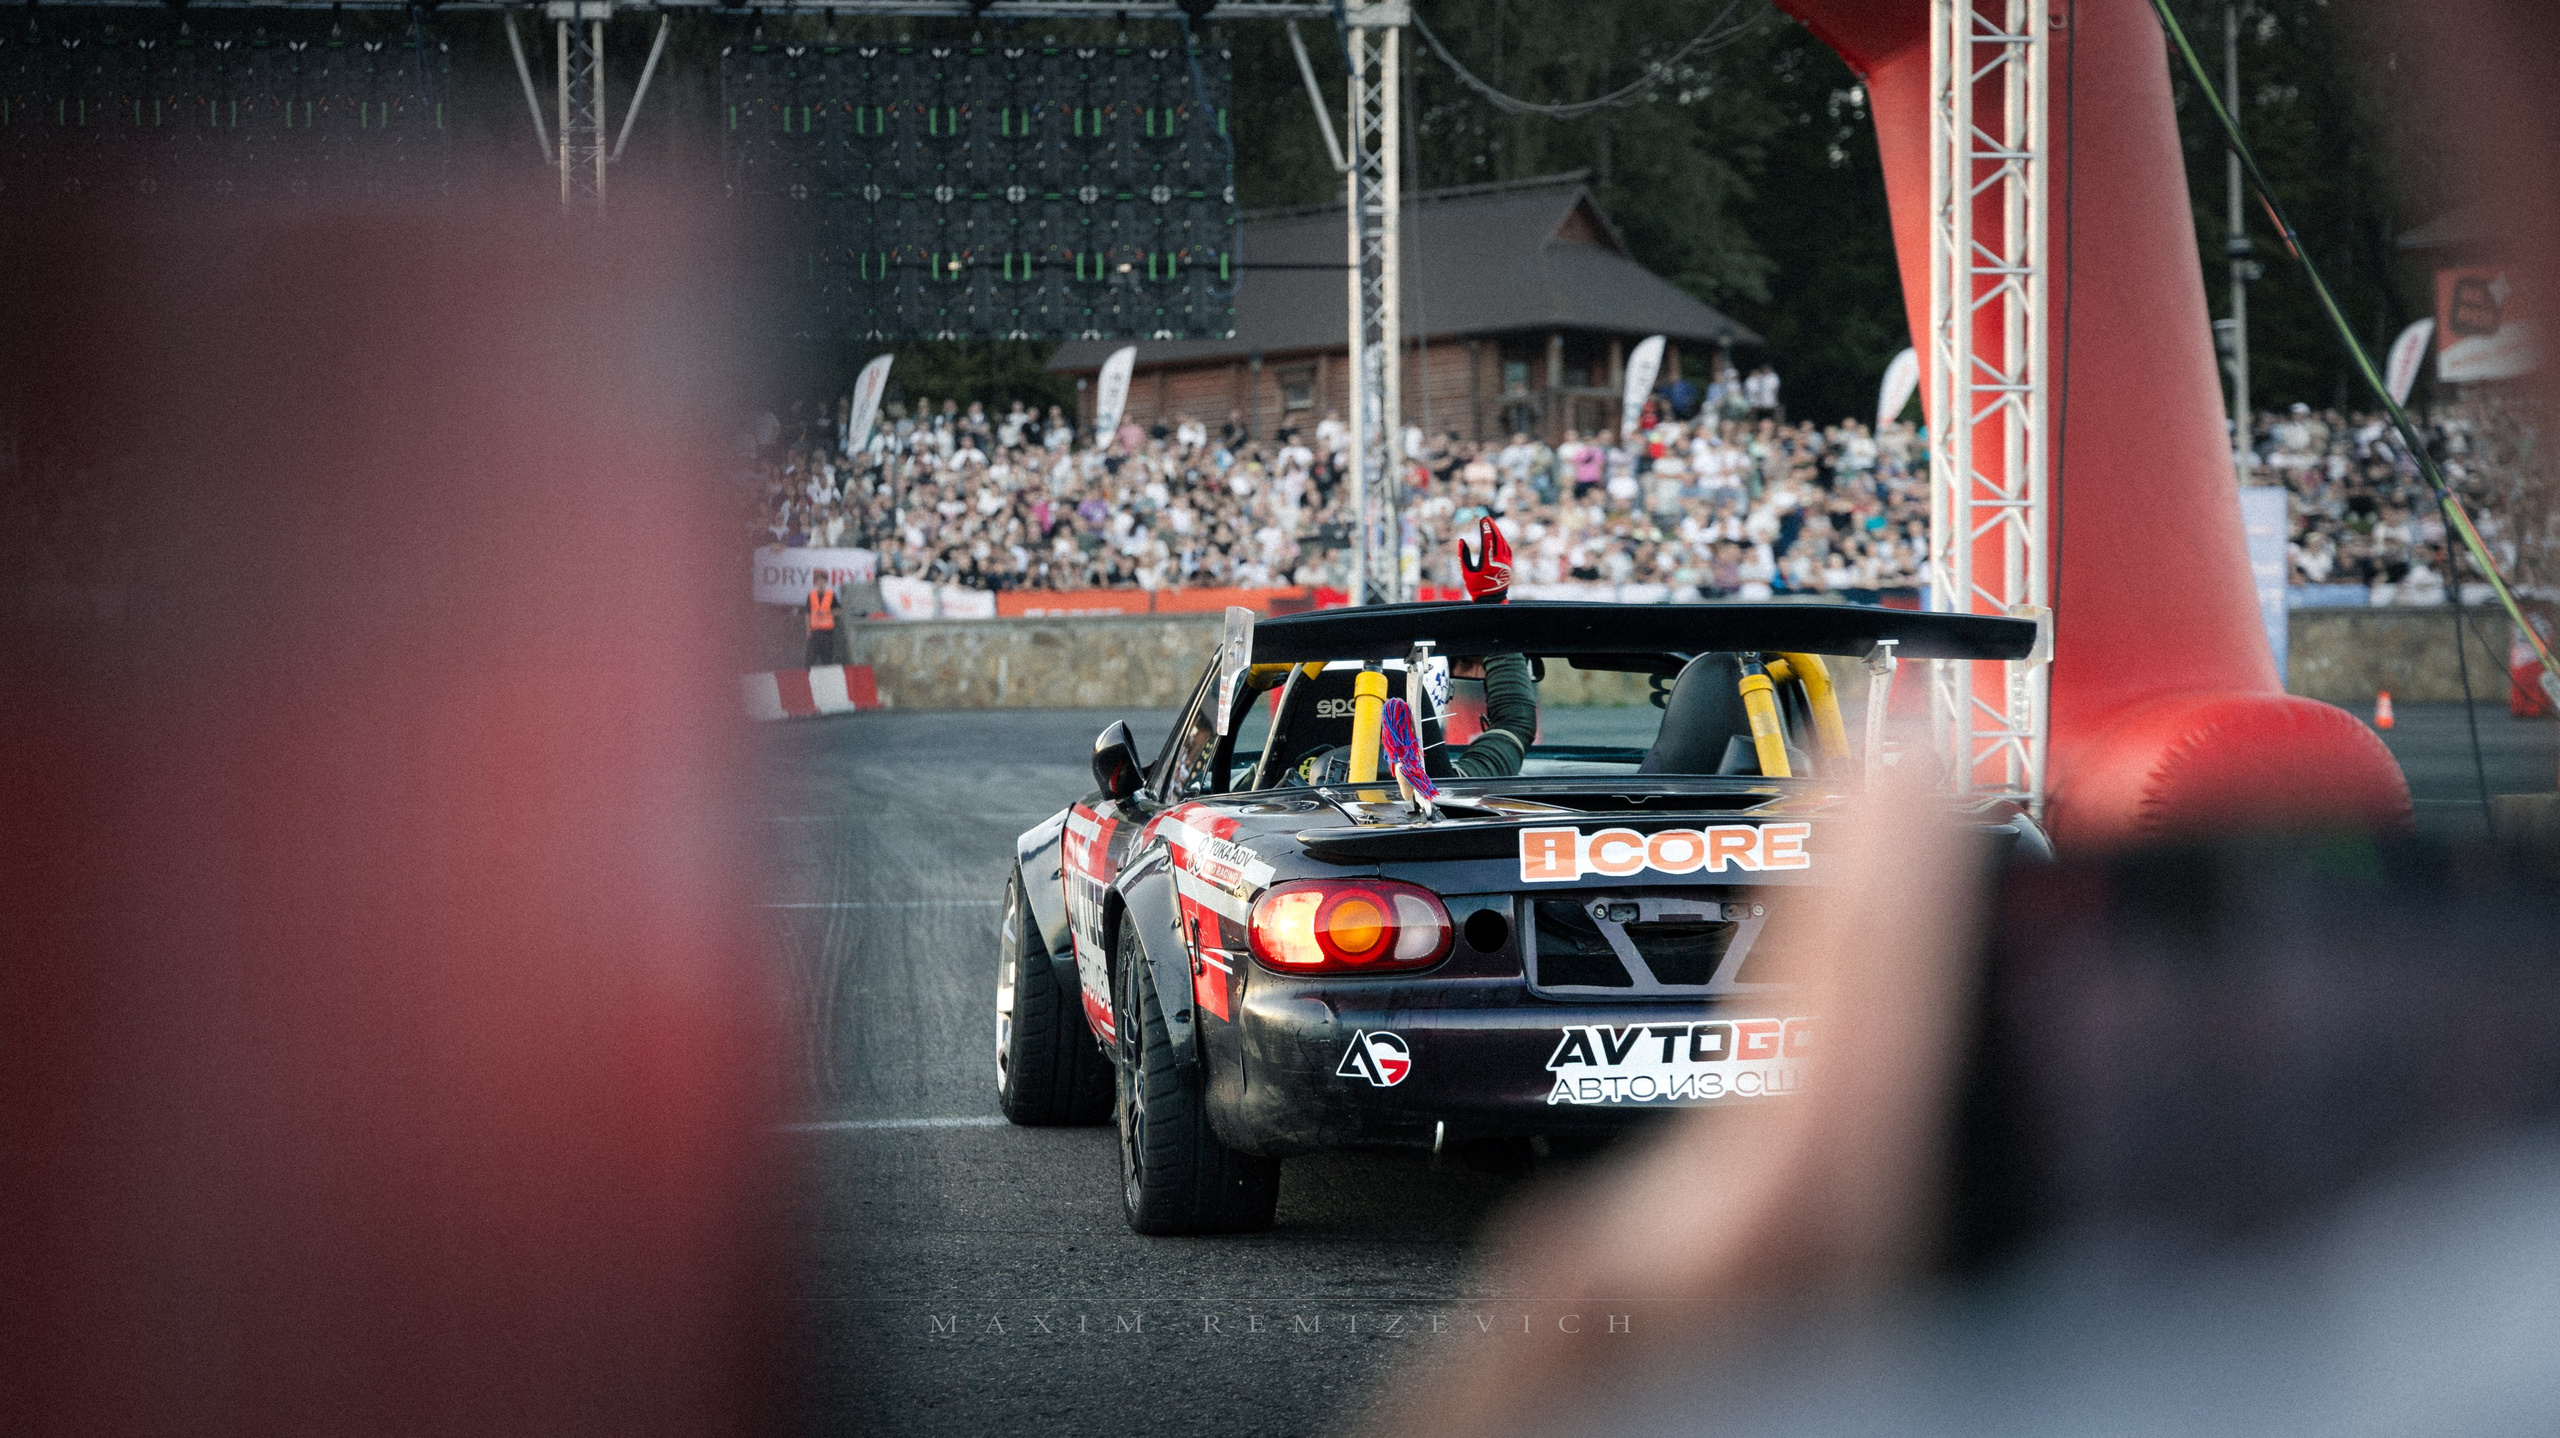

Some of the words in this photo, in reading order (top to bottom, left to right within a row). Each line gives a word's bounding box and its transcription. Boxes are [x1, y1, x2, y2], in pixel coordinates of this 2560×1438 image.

[1231, 847, 1254, 867] ADV
[1215, 865, 1240, 882] RACING
[1550, 1075, 1657, 1101] АВТО
[1669, 1072, 1723, 1098] ИЗ
